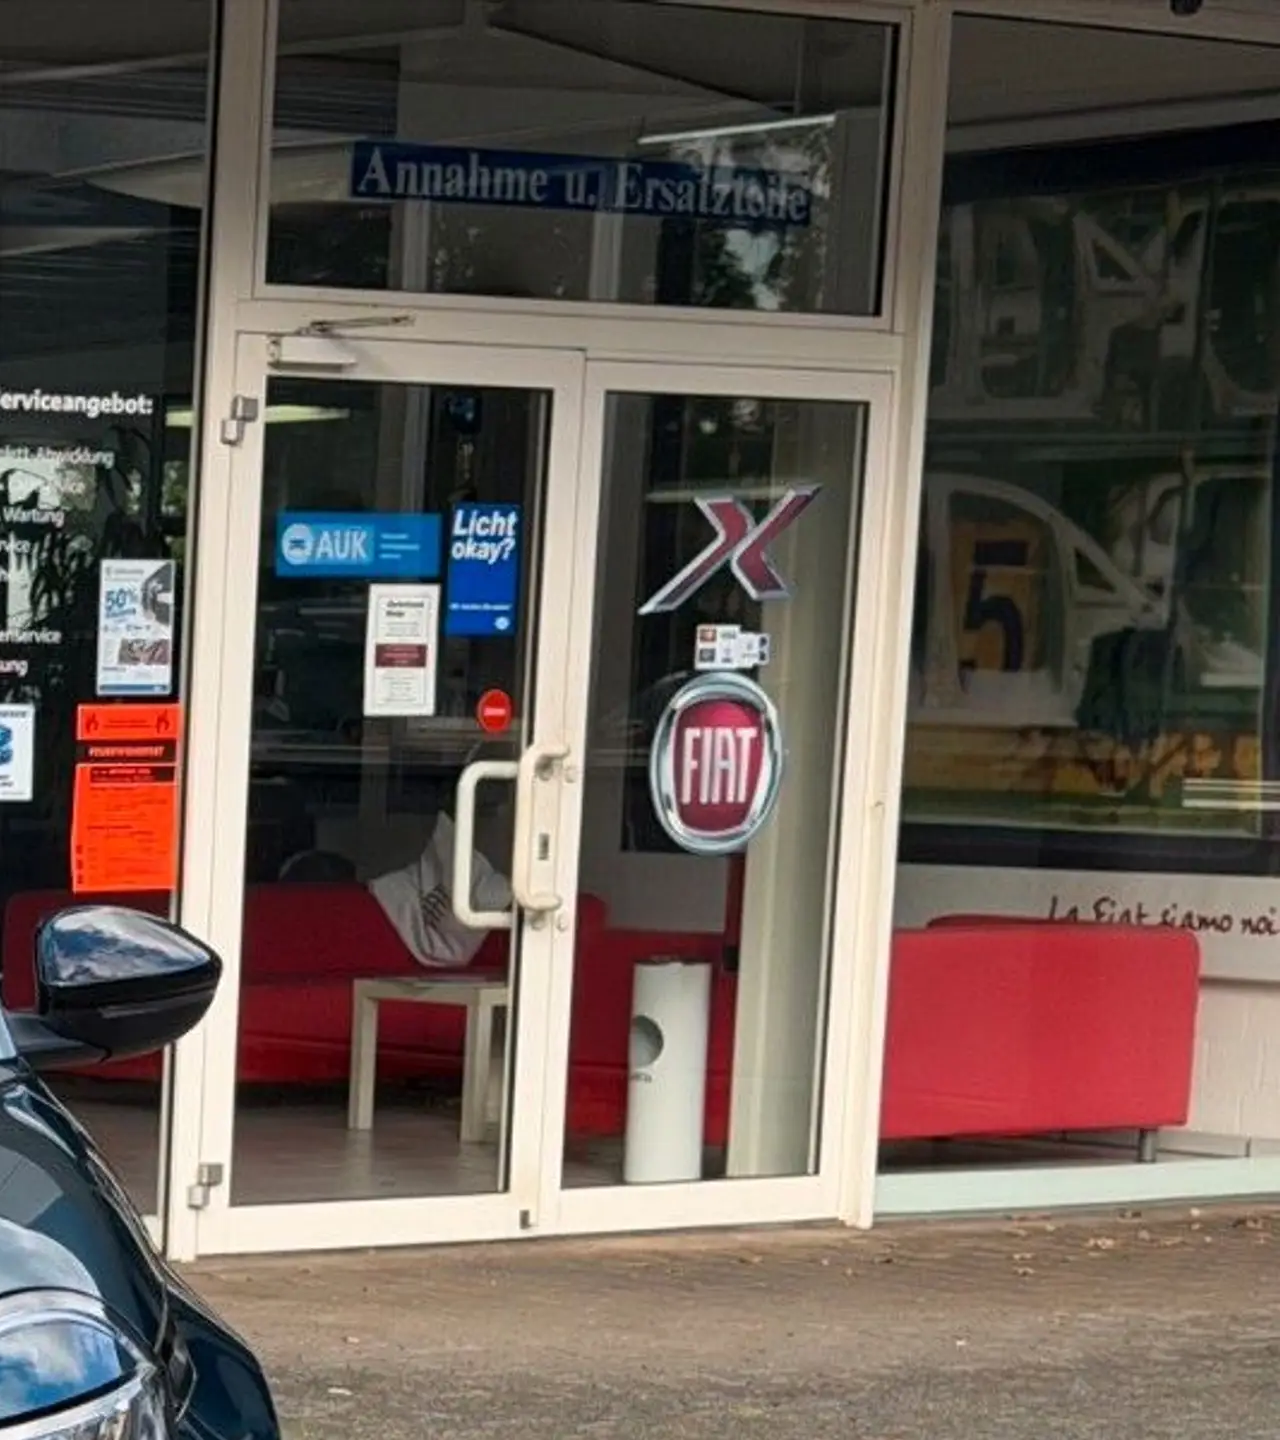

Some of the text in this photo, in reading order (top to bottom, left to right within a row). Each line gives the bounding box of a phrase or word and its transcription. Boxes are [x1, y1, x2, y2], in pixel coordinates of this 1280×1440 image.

[356, 146, 548, 201] Annahme
[566, 168, 597, 206] u.
[2, 507, 65, 528] Wartung
[452, 509, 519, 537] Licht
[451, 537, 517, 565] okay?
[683, 726, 758, 806] FIAT
[1093, 896, 1149, 926] Fiat
[1161, 903, 1233, 933] siamo
[1242, 907, 1279, 935] noi
